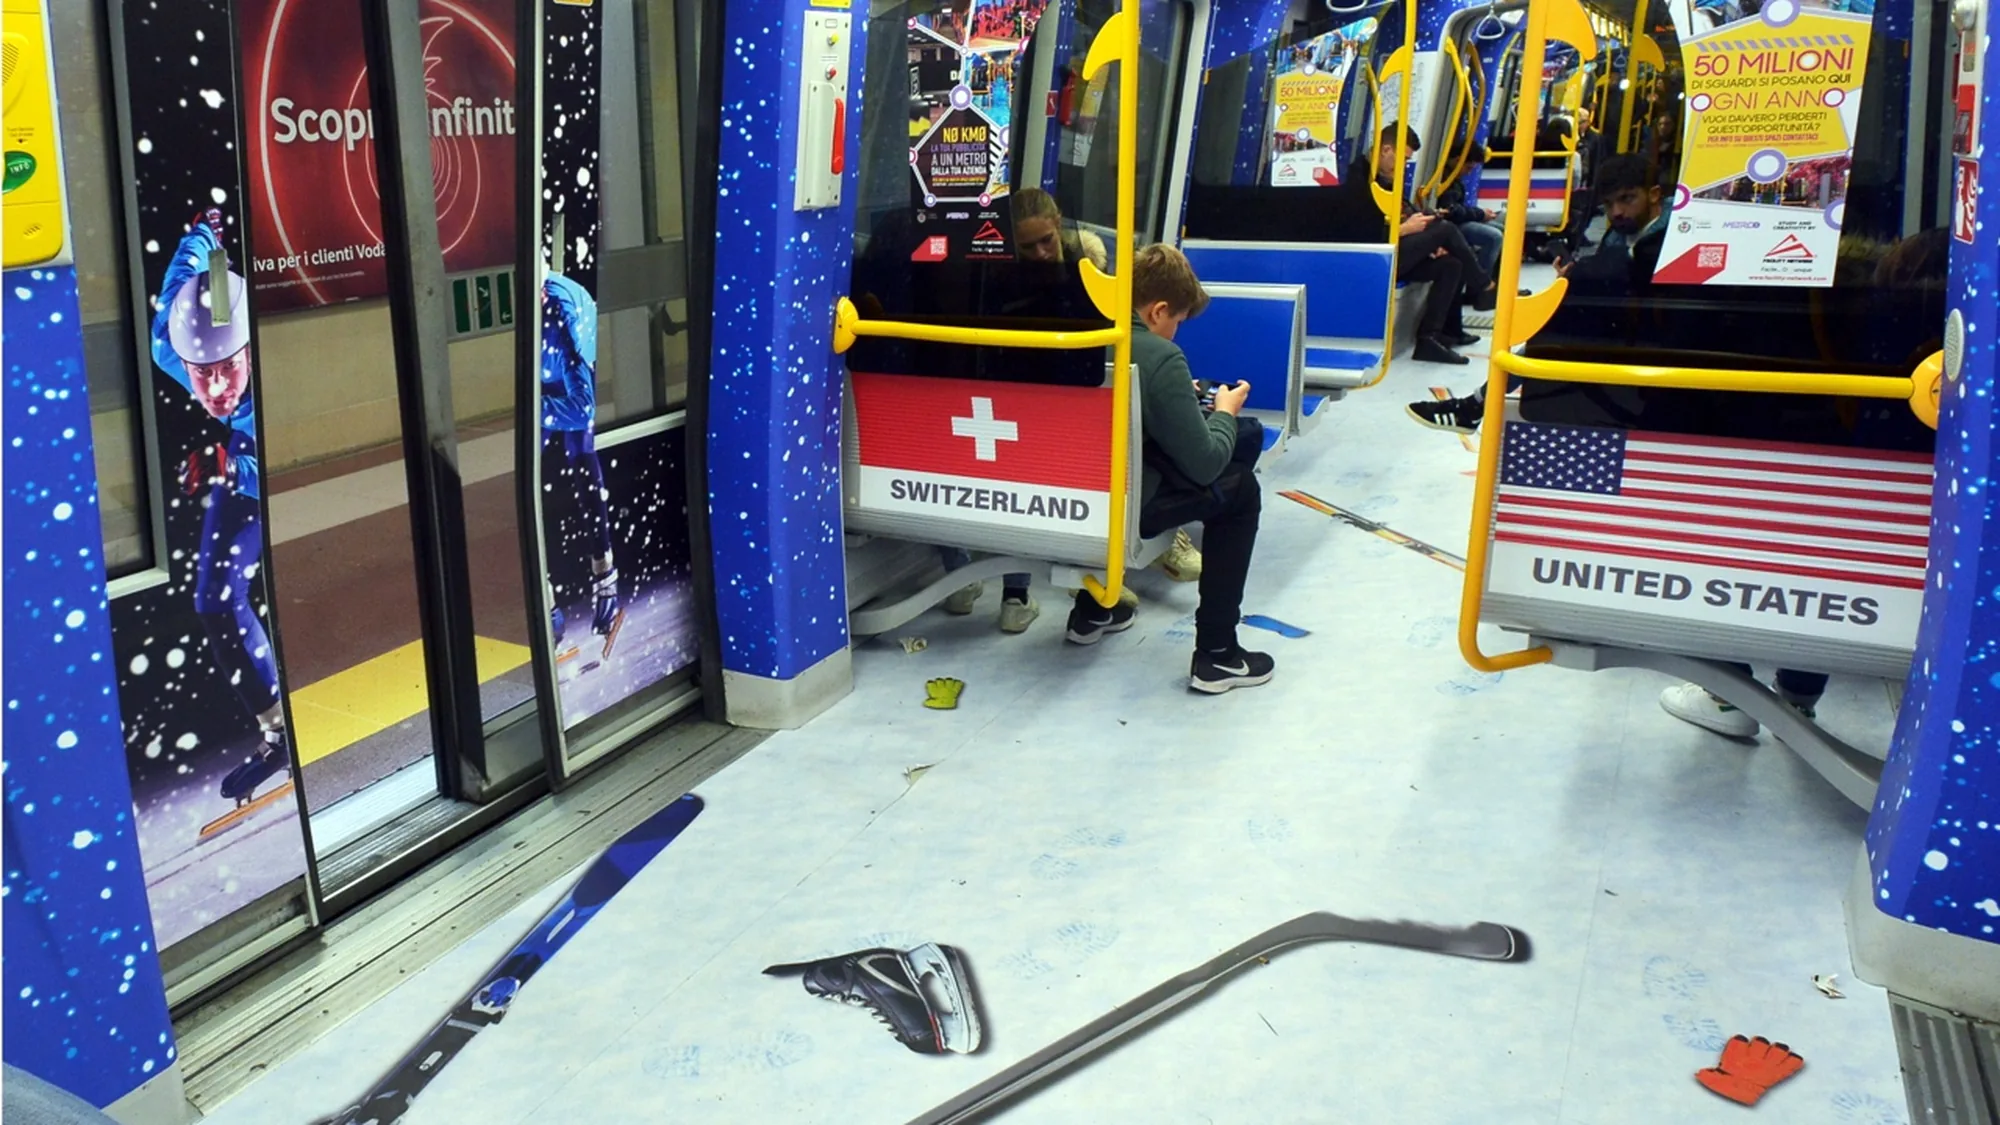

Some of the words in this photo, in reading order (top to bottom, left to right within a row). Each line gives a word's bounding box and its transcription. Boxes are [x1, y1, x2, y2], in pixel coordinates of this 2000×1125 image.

[1694, 55, 1729, 76] 50
[1738, 48, 1854, 75] MILIONI
[1692, 79, 1704, 90] DI
[1704, 77, 1756, 89] SGUARDI
[1759, 77, 1770, 87] SI
[1771, 75, 1826, 86] POSANO
[1828, 73, 1852, 84] QUI
[1690, 92, 1759, 112] OGNI
[1765, 87, 1846, 109] ANNO
[1702, 115, 1726, 123] VUOI
[1728, 113, 1777, 123] DAVVERO
[1778, 111, 1828, 121] PERDERTI
[931, 154, 938, 166] A
[940, 153, 953, 165] UN
[253, 257, 275, 273] iva
[278, 255, 301, 273] per
[304, 250, 309, 266] i
[311, 245, 354, 265] clienti
[355, 242, 386, 259] Voda
[890, 479, 1090, 521] SWITZERLAND
[1532, 557, 1693, 601] UNITED
[1702, 578, 1880, 626] STATES
